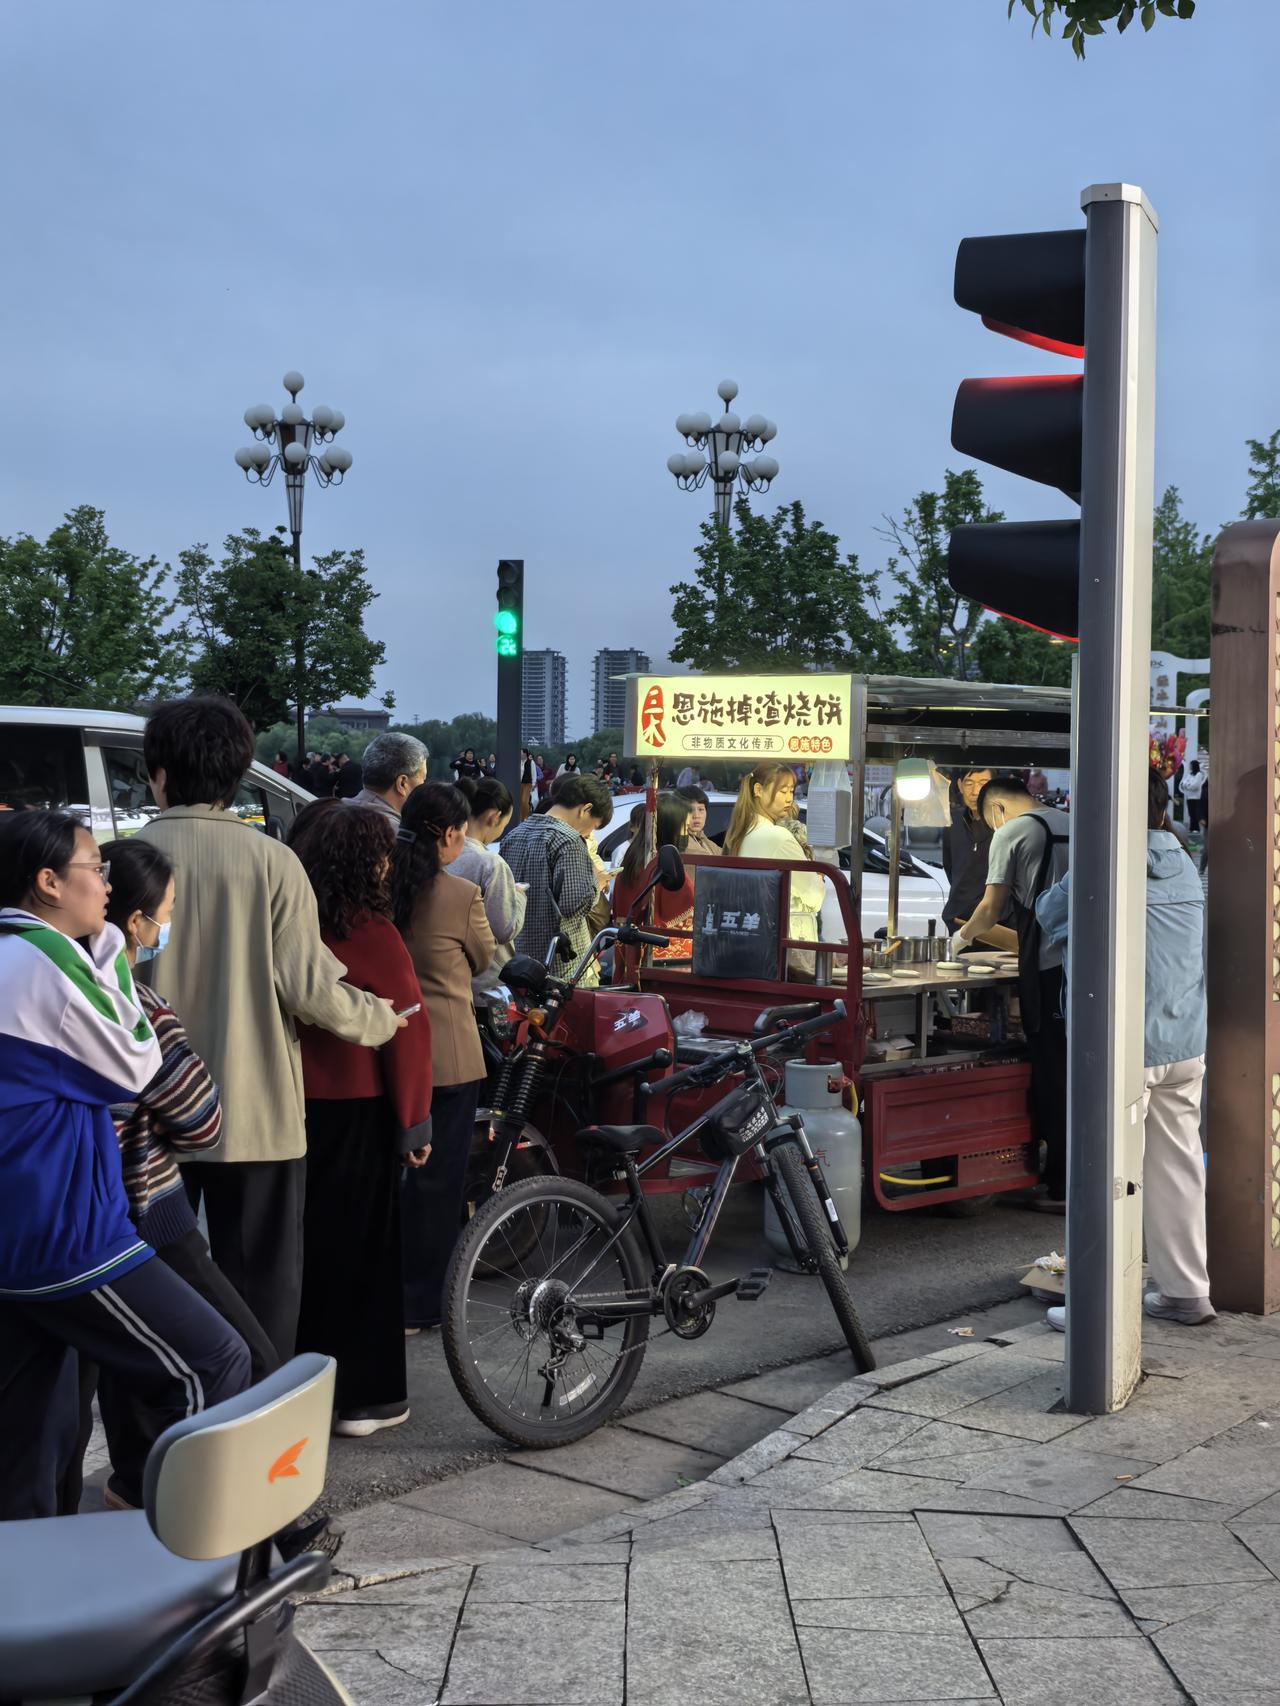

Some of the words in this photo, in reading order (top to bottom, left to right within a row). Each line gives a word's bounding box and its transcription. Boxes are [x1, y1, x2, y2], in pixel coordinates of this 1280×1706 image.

[672, 691, 842, 727] 恩施掉渣烧饼
[691, 736, 774, 750] 非物质文化传承
[788, 737, 832, 751] 恩施特色
[720, 911, 760, 930] 五羊
